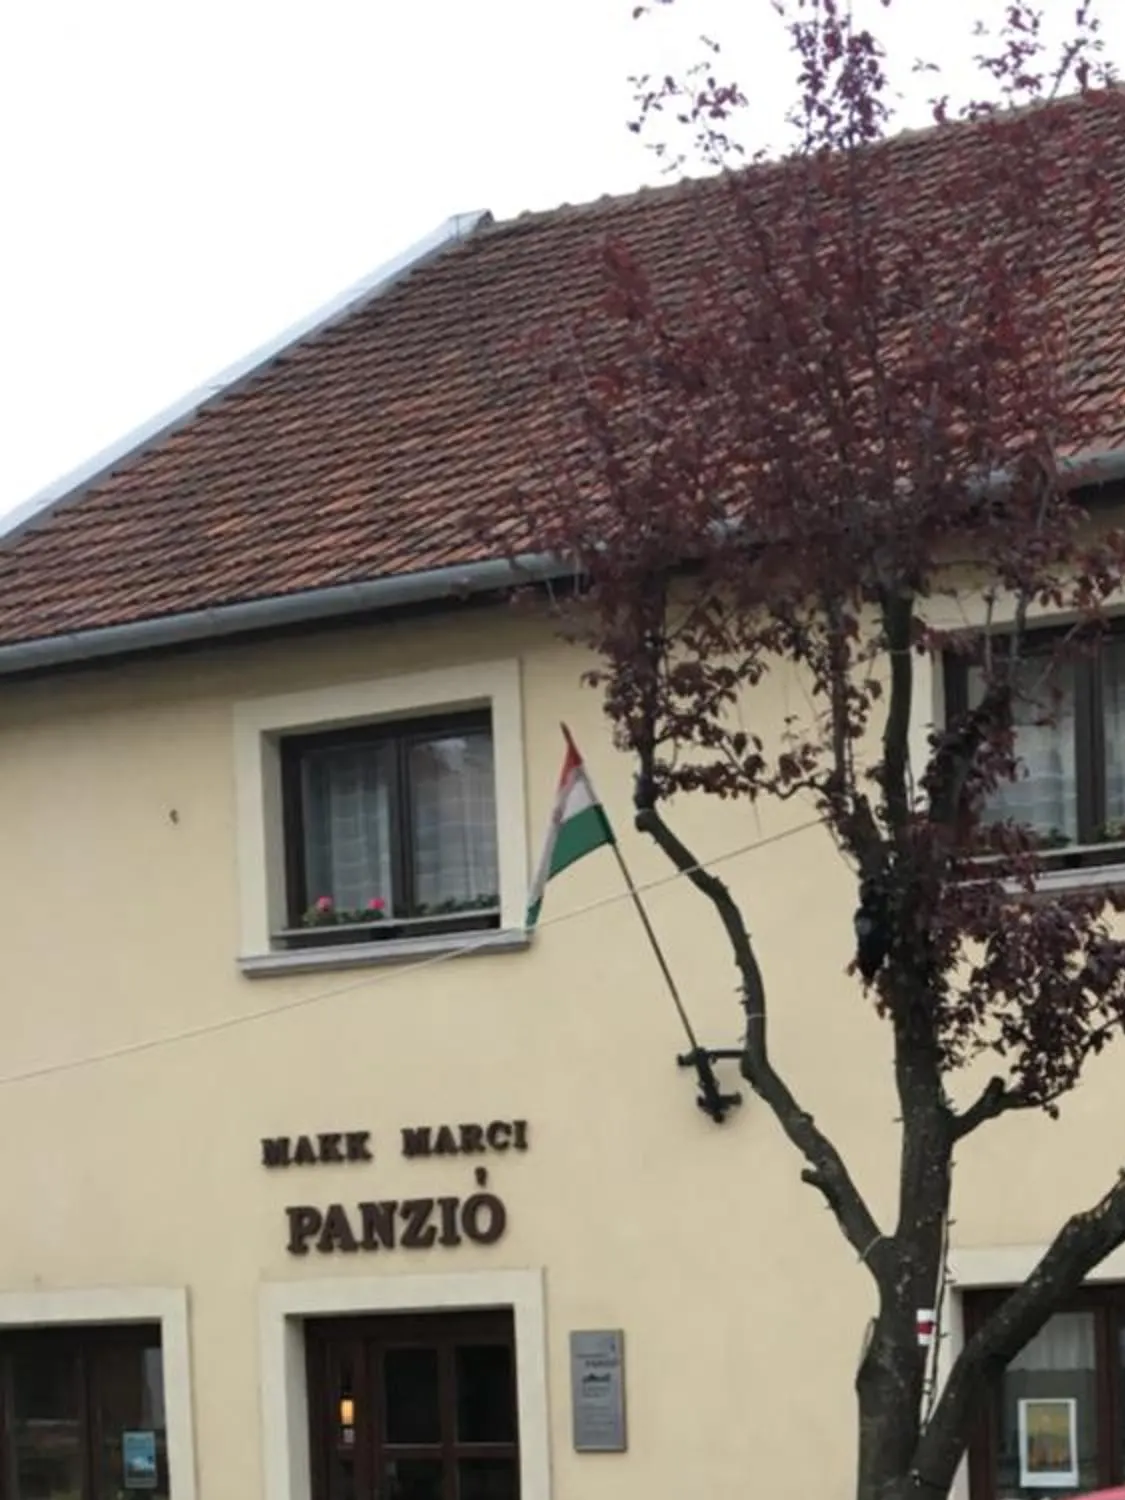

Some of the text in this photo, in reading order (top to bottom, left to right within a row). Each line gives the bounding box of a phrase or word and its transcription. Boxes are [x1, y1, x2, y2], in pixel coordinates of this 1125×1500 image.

[260, 1120, 529, 1168] MAKK MARCI
[285, 1166, 507, 1254] PANZIÓ
